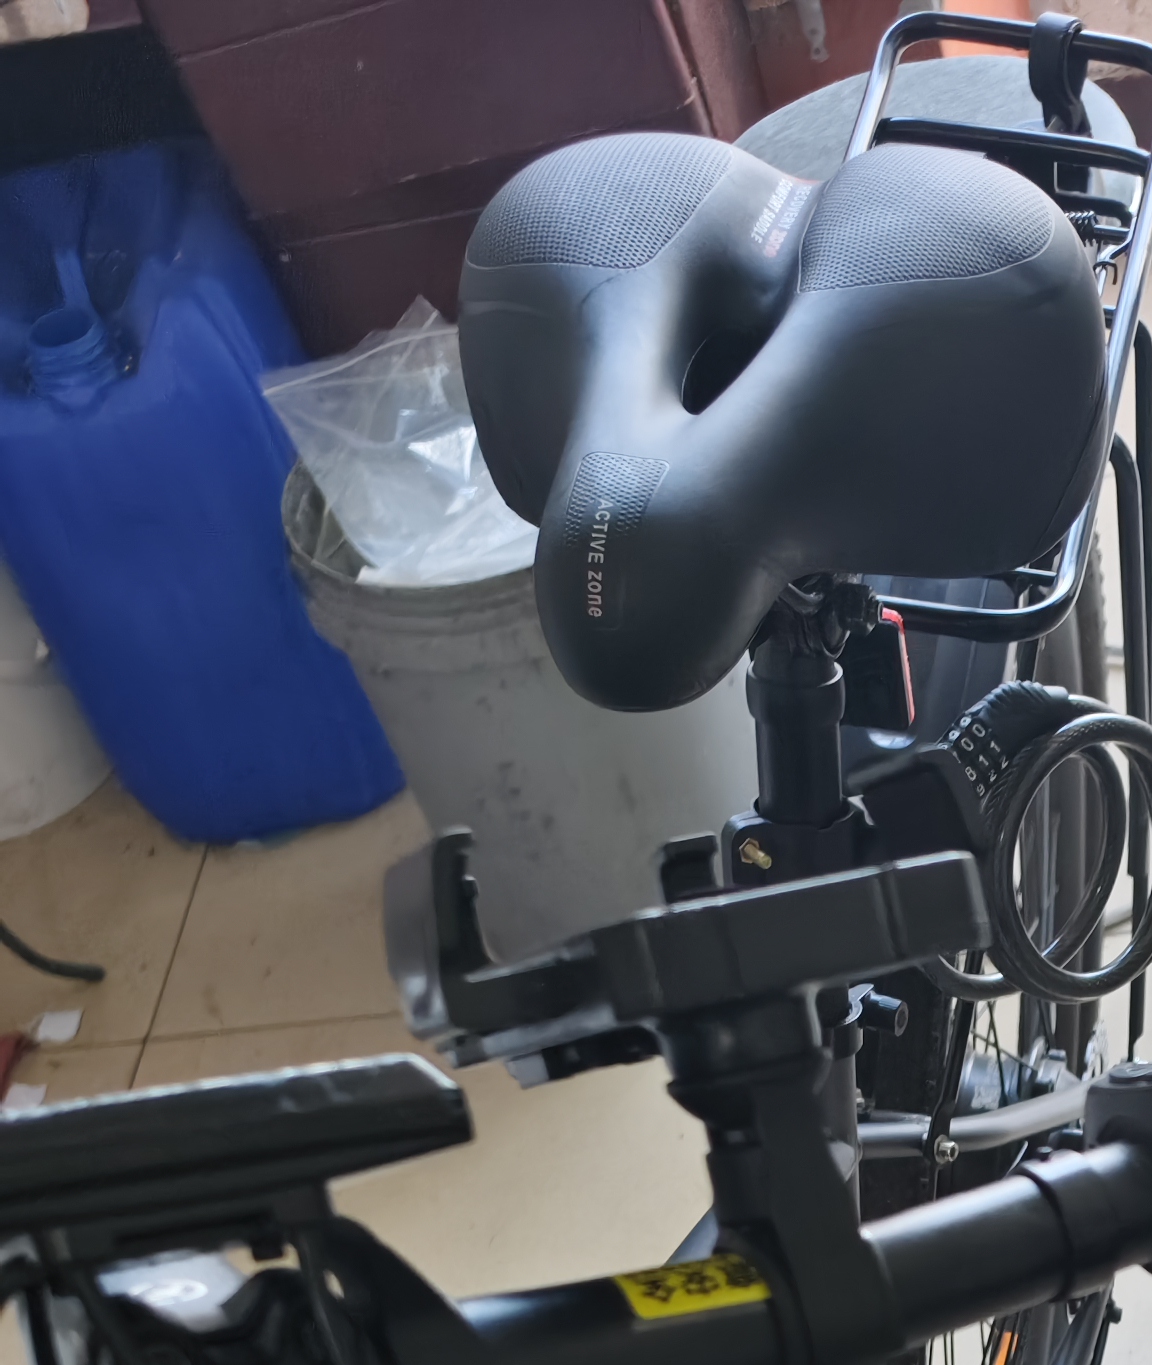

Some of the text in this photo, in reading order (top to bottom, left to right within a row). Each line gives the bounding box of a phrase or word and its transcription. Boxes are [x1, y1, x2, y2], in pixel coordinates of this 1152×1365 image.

[750, 207, 776, 244] SADDLE
[587, 499, 614, 617] ACTIVE zone
